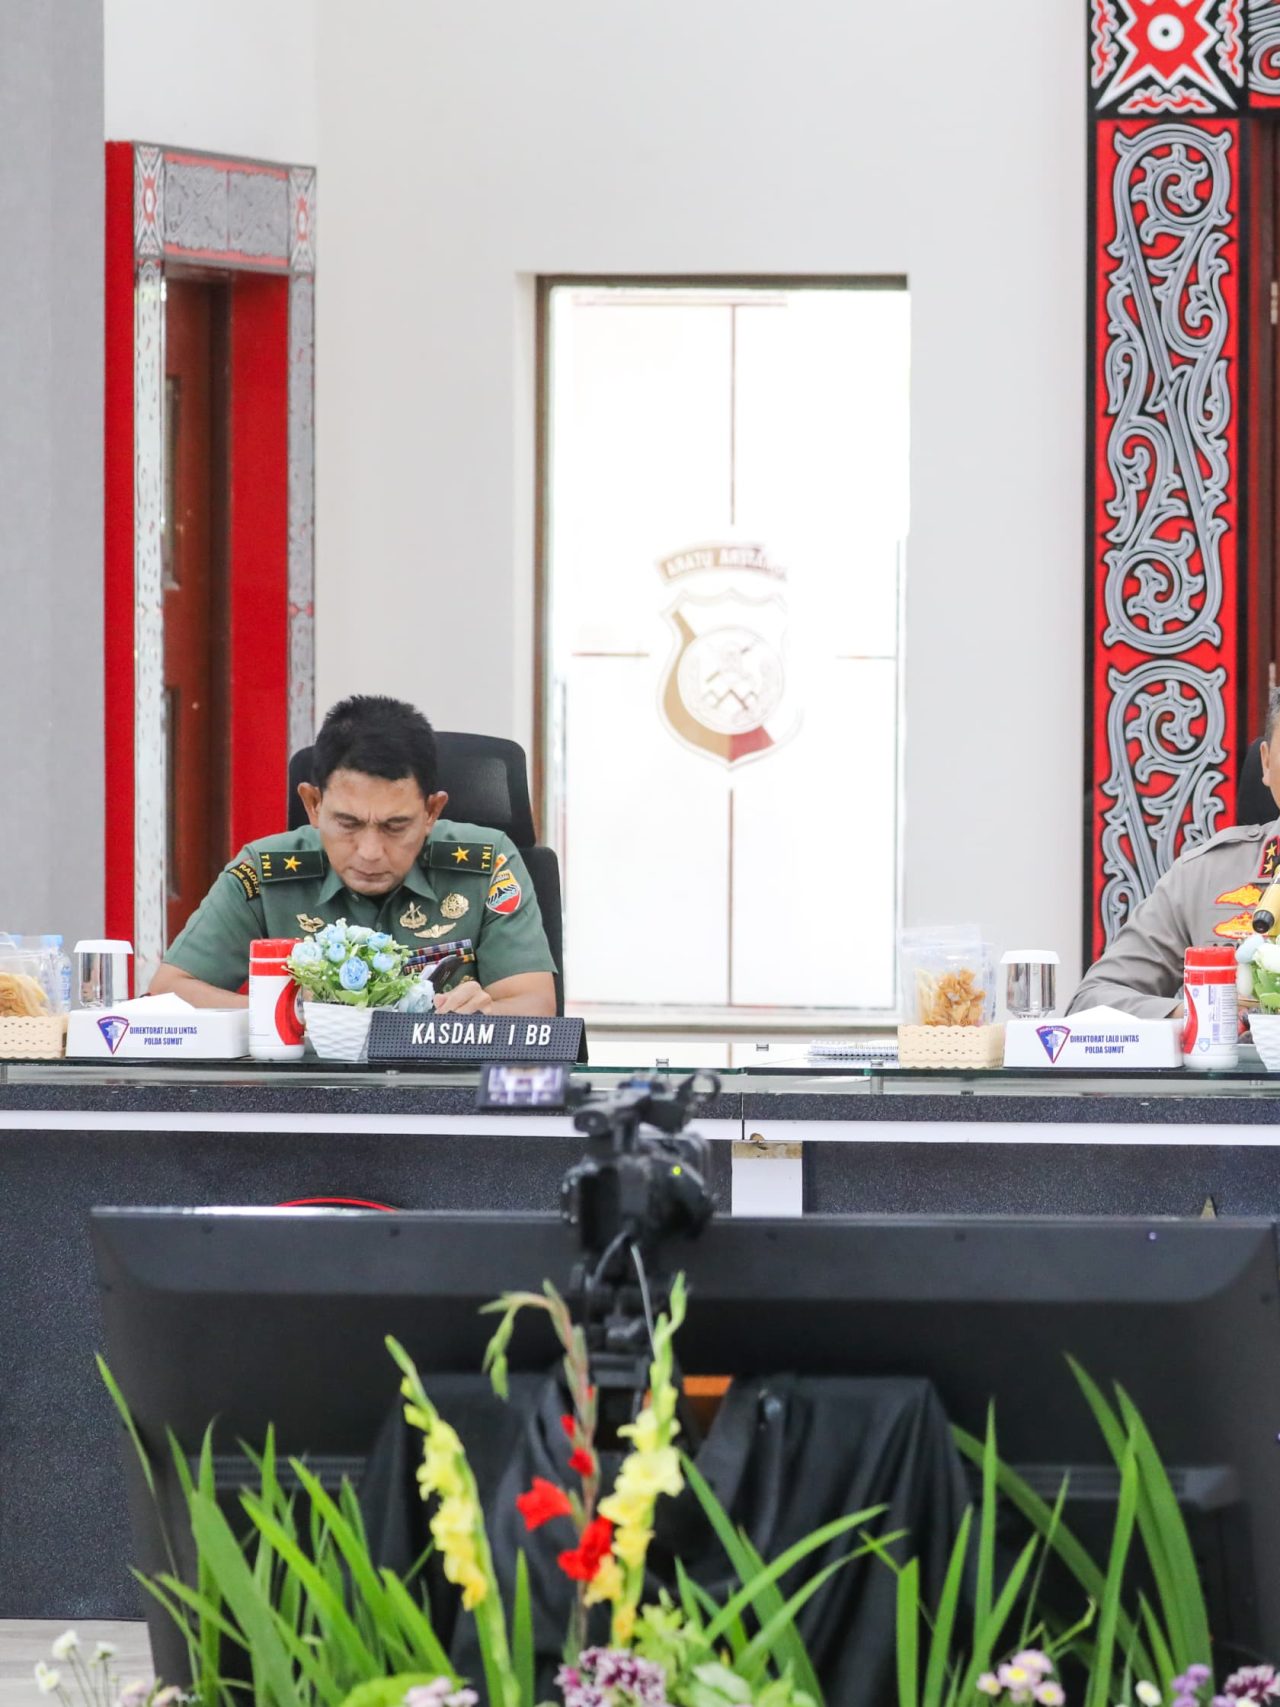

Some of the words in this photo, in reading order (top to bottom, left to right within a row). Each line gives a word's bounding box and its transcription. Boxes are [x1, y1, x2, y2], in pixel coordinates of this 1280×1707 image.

[481, 846, 492, 870] TNI
[261, 854, 272, 877] TNI
[129, 1026, 163, 1035] DIREKTORAT
[164, 1026, 178, 1034] LALU
[411, 1022, 495, 1045] KASDAM
[508, 1024, 515, 1046] I
[525, 1024, 551, 1046] BB
[143, 1037, 162, 1045] POLDA
[163, 1037, 183, 1045] SUMUT
[1069, 1035, 1104, 1043] DIREKTORAT
[1120, 1034, 1139, 1042] LINTAS
[1085, 1046, 1103, 1054] POLDA
